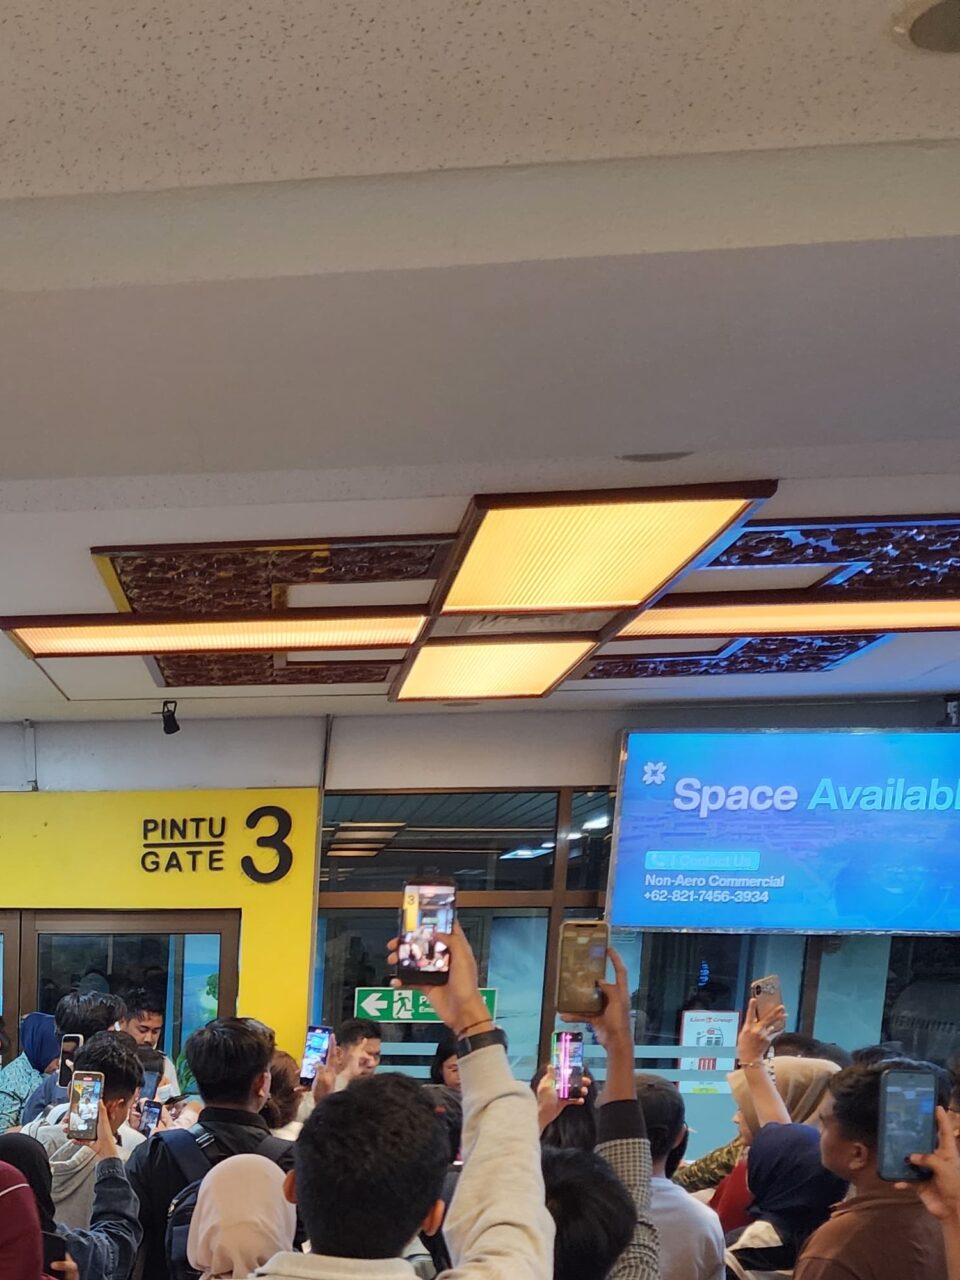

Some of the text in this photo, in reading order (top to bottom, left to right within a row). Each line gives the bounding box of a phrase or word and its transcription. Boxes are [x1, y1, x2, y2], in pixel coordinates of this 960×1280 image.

[673, 777, 798, 818] Space
[143, 816, 226, 840] PINTU
[241, 805, 293, 884] 3
[141, 850, 224, 872] GATE
[645, 874, 785, 888] Non-Aero Commercial
[644, 889, 769, 903] +62-821-7456-3934
